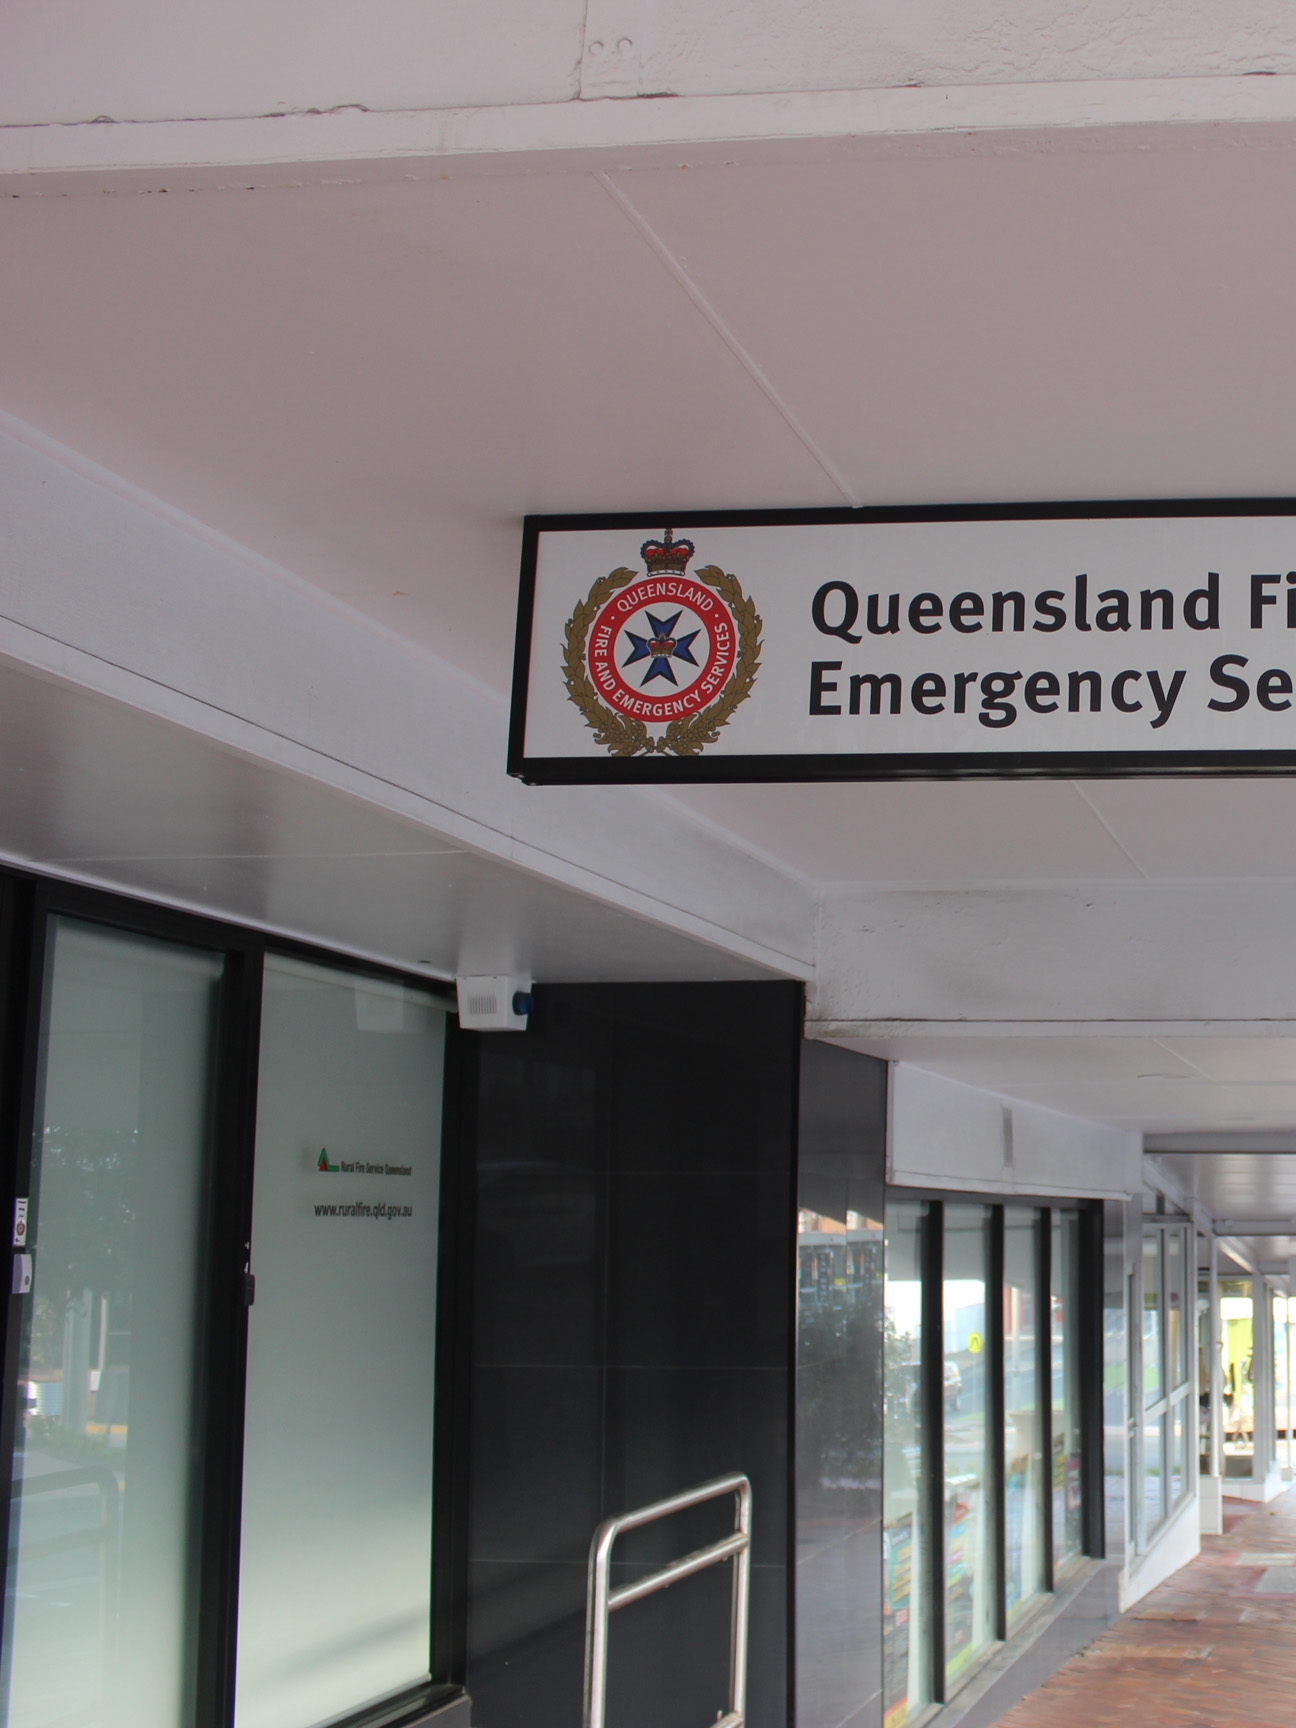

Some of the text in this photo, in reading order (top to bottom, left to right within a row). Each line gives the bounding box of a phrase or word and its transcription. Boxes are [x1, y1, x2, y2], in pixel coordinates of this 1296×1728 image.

[616, 582, 714, 613] QUEENSLAND
[811, 571, 1220, 645] Queensland
[594, 621, 730, 717] FIRE AND EMERGENCY SERVICES
[808, 660, 1187, 729] Emergency
[340, 1161, 355, 1173] Rural
[355, 1162, 365, 1173] Fire
[366, 1163, 384, 1175] Service
[314, 1202, 413, 1221] www.ruralfire.qld.gov.au
